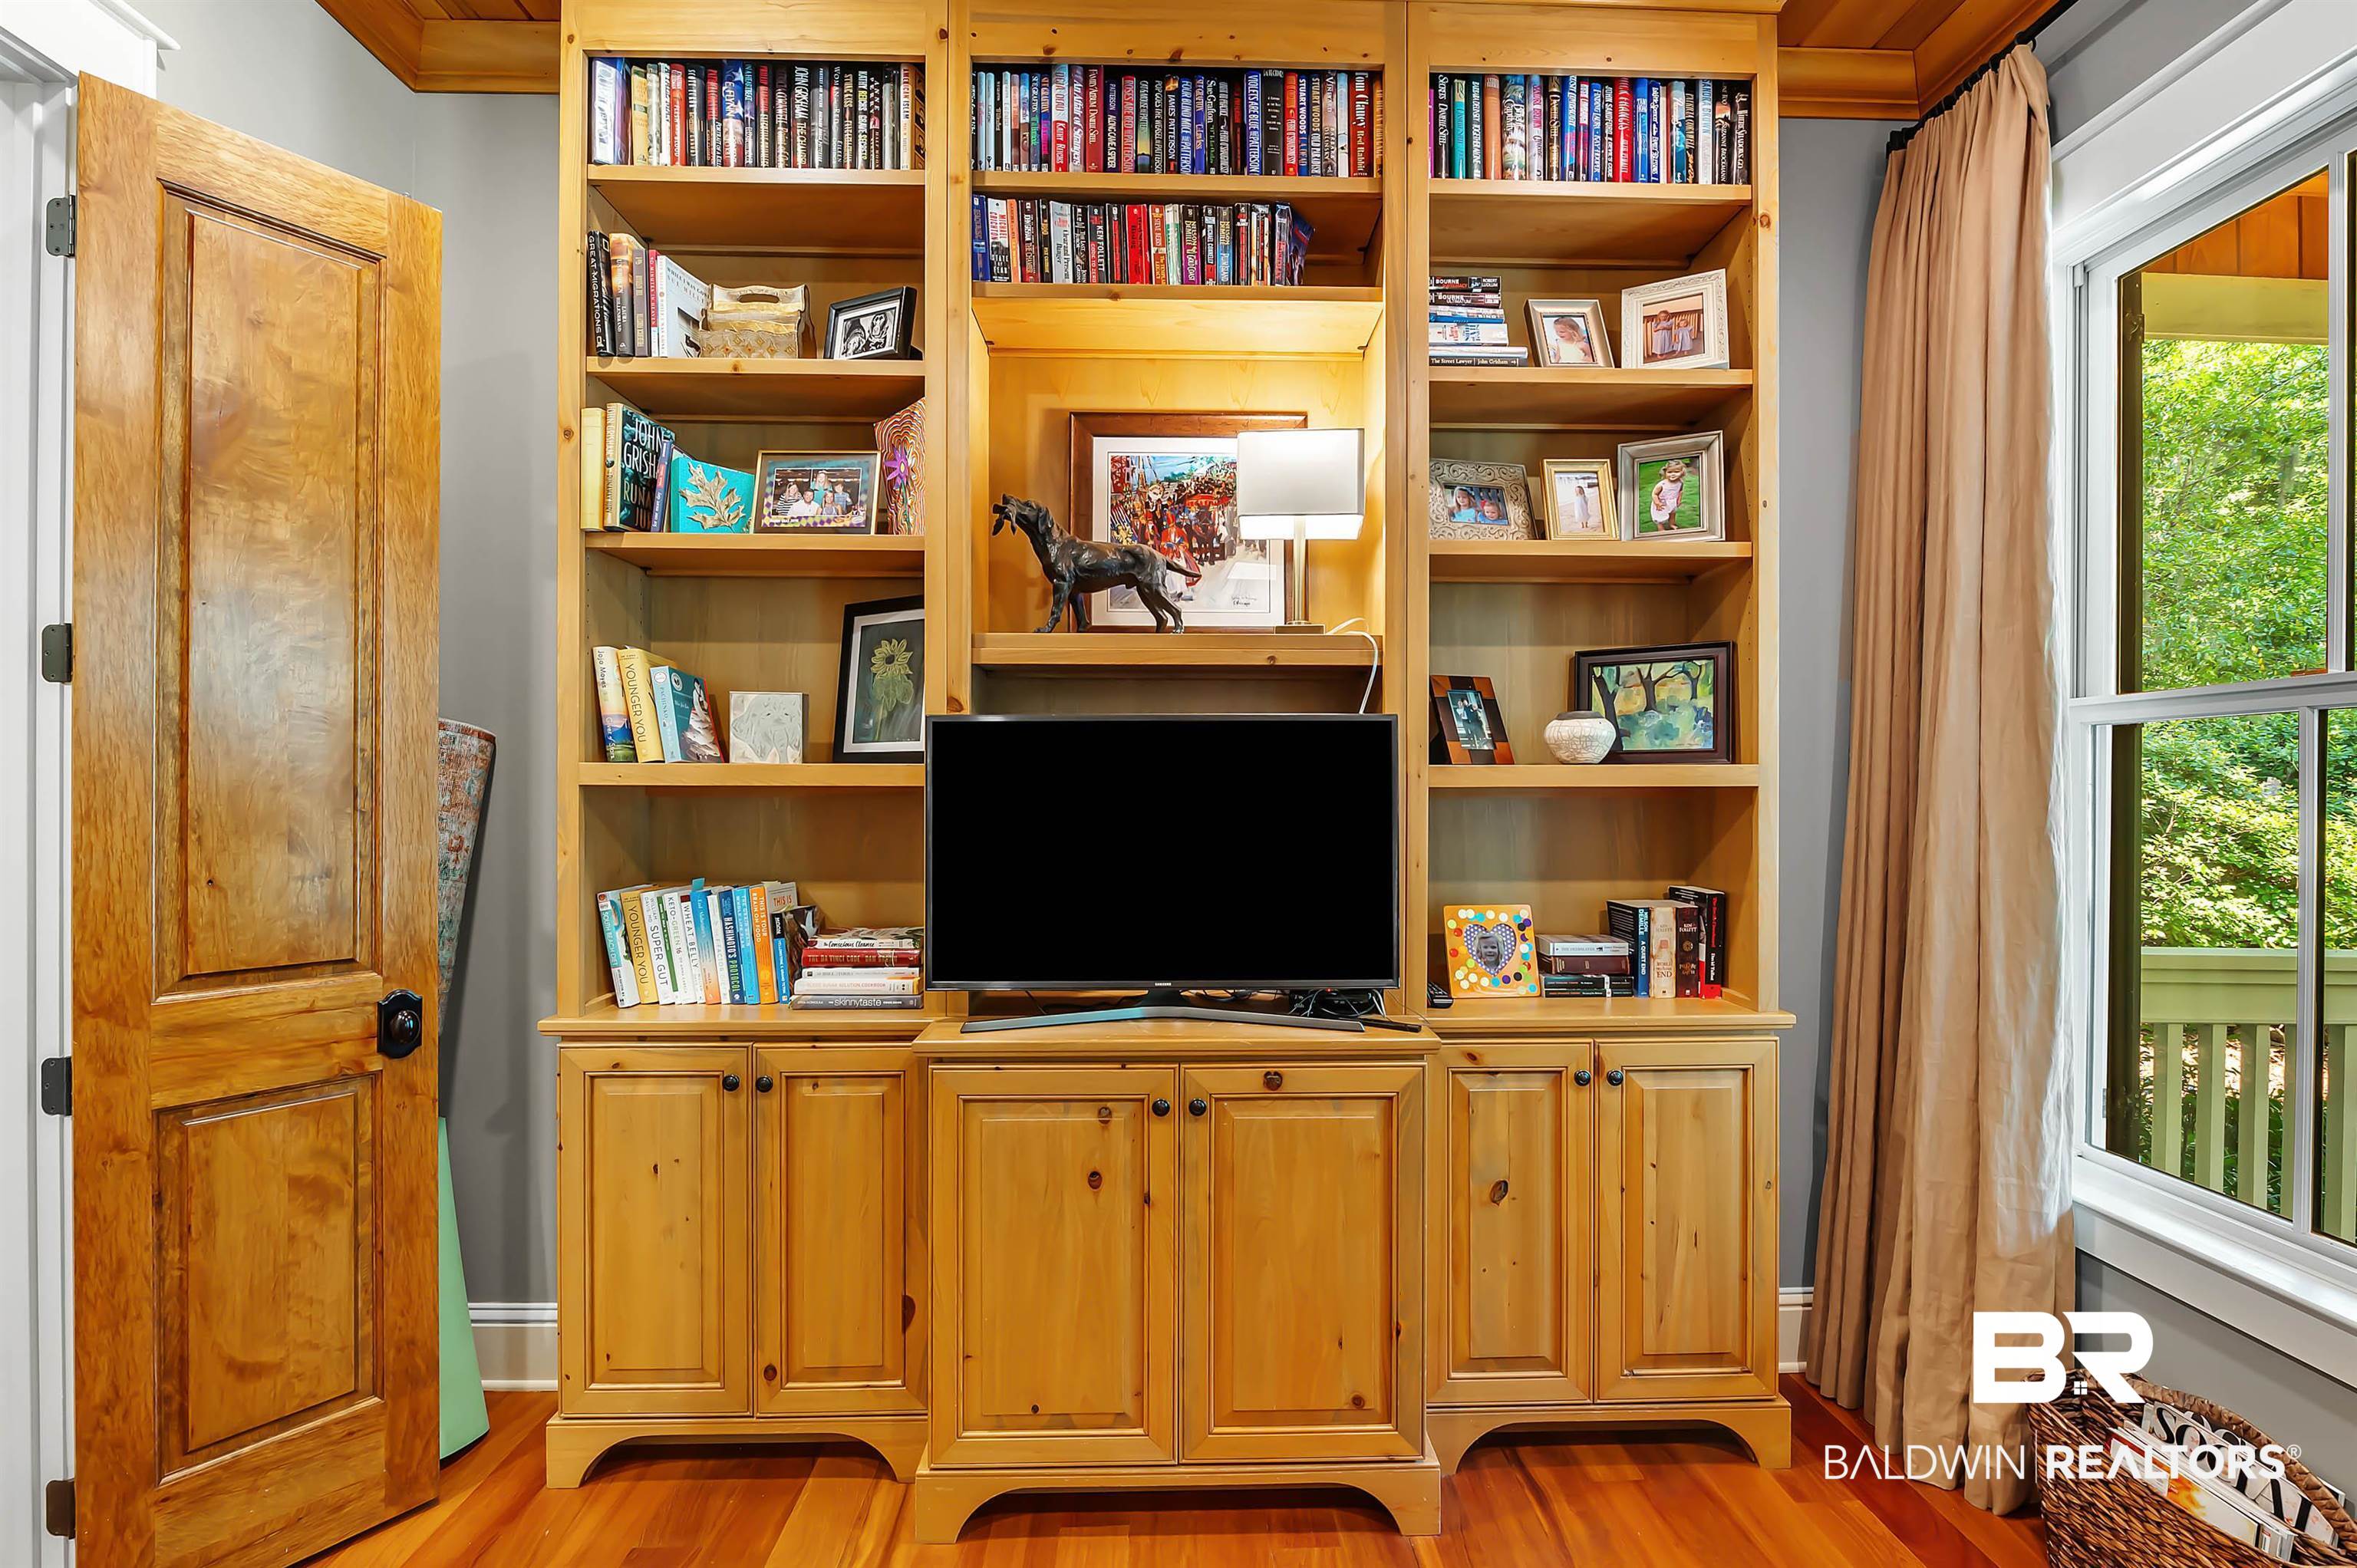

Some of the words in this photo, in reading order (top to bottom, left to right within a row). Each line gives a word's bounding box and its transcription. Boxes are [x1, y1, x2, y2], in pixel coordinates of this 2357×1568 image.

[794, 66, 809, 86] JOHN
[858, 71, 867, 89] KATHY
[1074, 81, 1083, 93] An
[1207, 81, 1216, 94] Sue
[1355, 72, 1368, 91] Tom
[1124, 80, 1134, 101] ROSES
[1181, 81, 1192, 98] FOUR
[1248, 75, 1259, 101] VIOLETS
[1312, 78, 1320, 104] STUART
[795, 87, 809, 119] GRISHAM
[858, 91, 867, 111] REICHS
[1074, 94, 1083, 117] Affair
[1124, 101, 1134, 115] ARE
[1181, 98, 1192, 117] BLIND
[1207, 95, 1216, 123] Grafton
[1248, 101, 1259, 114] ARE
[1352, 94, 1369, 128] Clancy
[1074, 117, 1083, 126] of
[1108, 114, 1116, 132] ALONG
[1124, 116, 1134, 128] RED
[1181, 118, 1192, 134] MICE
[1248, 114, 1259, 130] BLUE
[1312, 105, 1320, 132] WOODS
[1502, 99, 1515, 132] Captivity
[1056, 123, 1065, 141] KATHY
[1108, 132, 1116, 147] CAME
[1311, 133, 1320, 147] COLD
[1056, 143, 1065, 164] REICHS
[1071, 127, 1083, 166] Strangers
[1123, 134, 1134, 172] PATTERSON
[1248, 137, 1259, 172] PATTERSON
[1108, 151, 1116, 169] SPIDER
[1357, 147, 1365, 171] Rabbit
[990, 211, 999, 240] CRICHTON
[999, 214, 1007, 239] MICHAEL
[591, 269, 602, 333] MIGRATIONS
[633, 418, 663, 452] JOHN
[624, 442, 658, 479] GRISH
[624, 481, 653, 508] RUNA
[625, 664, 643, 717] YOUNGER
[635, 719, 646, 743] YOU
[773, 896, 786, 907] THIS
[787, 896, 792, 904] IS
[668, 897, 680, 946] KETO-GREEN
[628, 906, 644, 959] YOUNGER
[637, 960, 648, 984] YOU
[683, 905, 694, 938] WHEAT
[689, 941, 699, 968] BELLY
[724, 917, 737, 959] HASHIMOTO'S
[651, 925, 663, 960] SUPER
[657, 964, 668, 986] GUT
[729, 960, 740, 992] PROTOCOL
[834, 998, 882, 1007] skinnytaste
